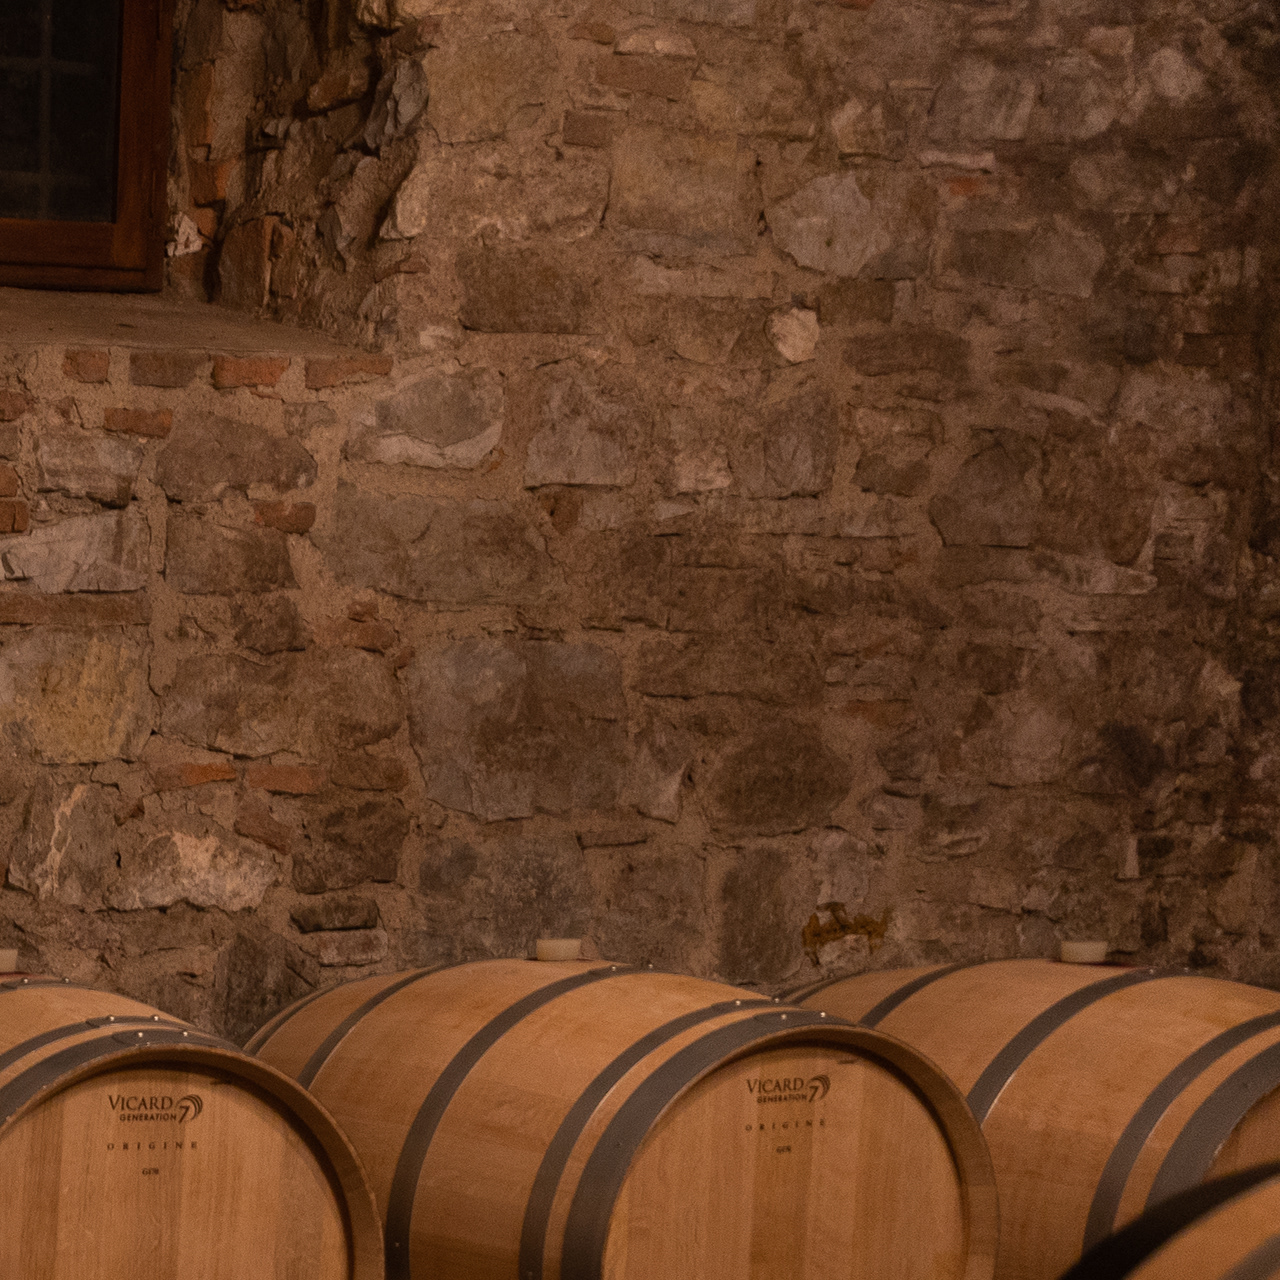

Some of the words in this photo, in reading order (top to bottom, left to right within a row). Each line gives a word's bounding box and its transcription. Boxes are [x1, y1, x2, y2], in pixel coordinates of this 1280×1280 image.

[746, 1077, 804, 1094] VICARD
[108, 1094, 174, 1110] VICARD
[756, 1093, 808, 1104] GENERATION
[119, 1112, 177, 1122] GENERATION
[745, 1118, 825, 1132] ORIGINE
[107, 1140, 198, 1151] ORIGINE
